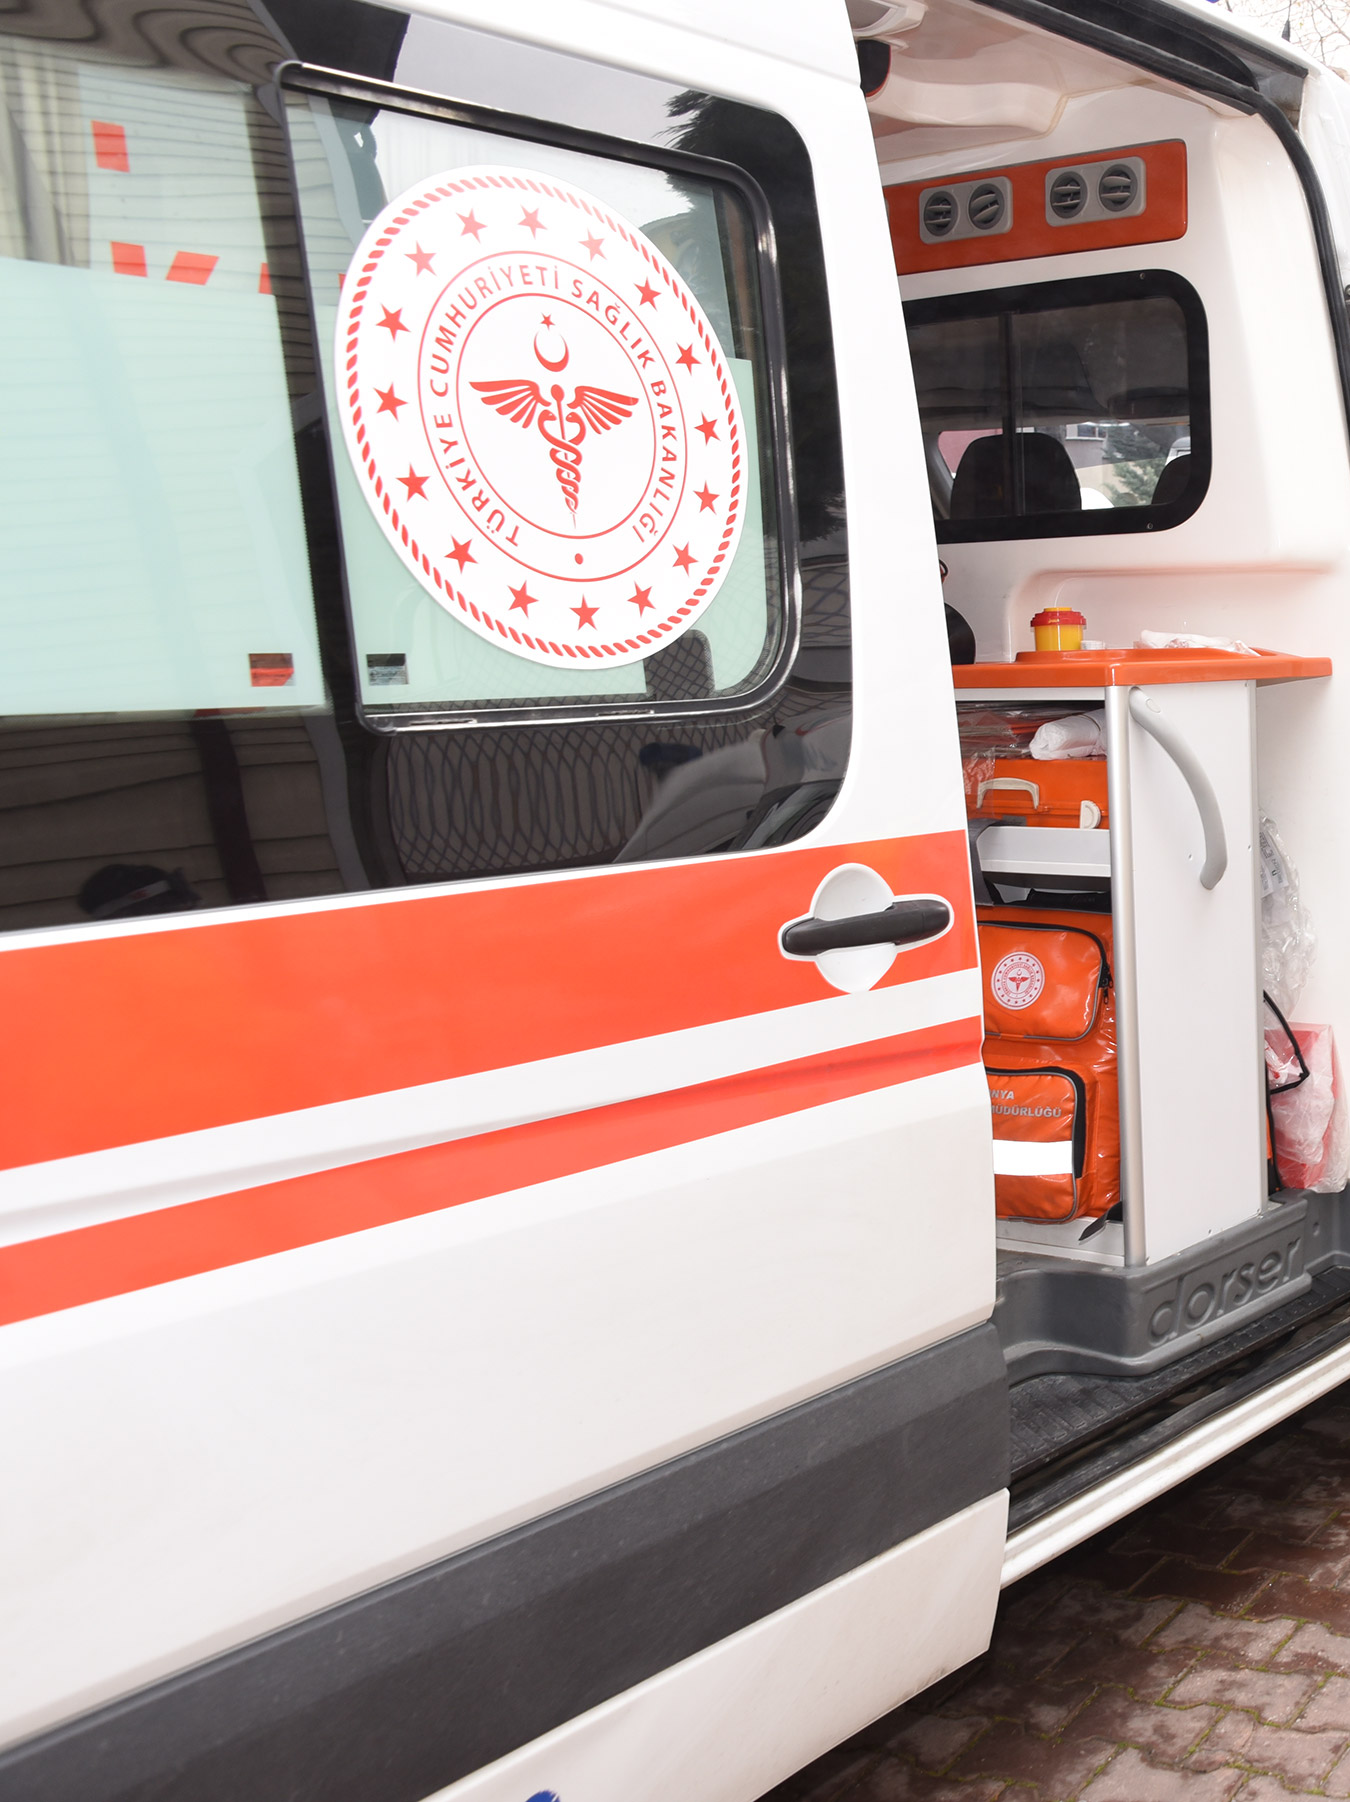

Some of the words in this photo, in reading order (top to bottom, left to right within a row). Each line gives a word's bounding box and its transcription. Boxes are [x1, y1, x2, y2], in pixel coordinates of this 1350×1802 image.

[429, 264, 559, 398] CUMHURİYETİ
[571, 278, 656, 370] SAĞLIK
[433, 413, 520, 548] TÜRKİYE
[631, 379, 679, 544] BAKANLIĞI
